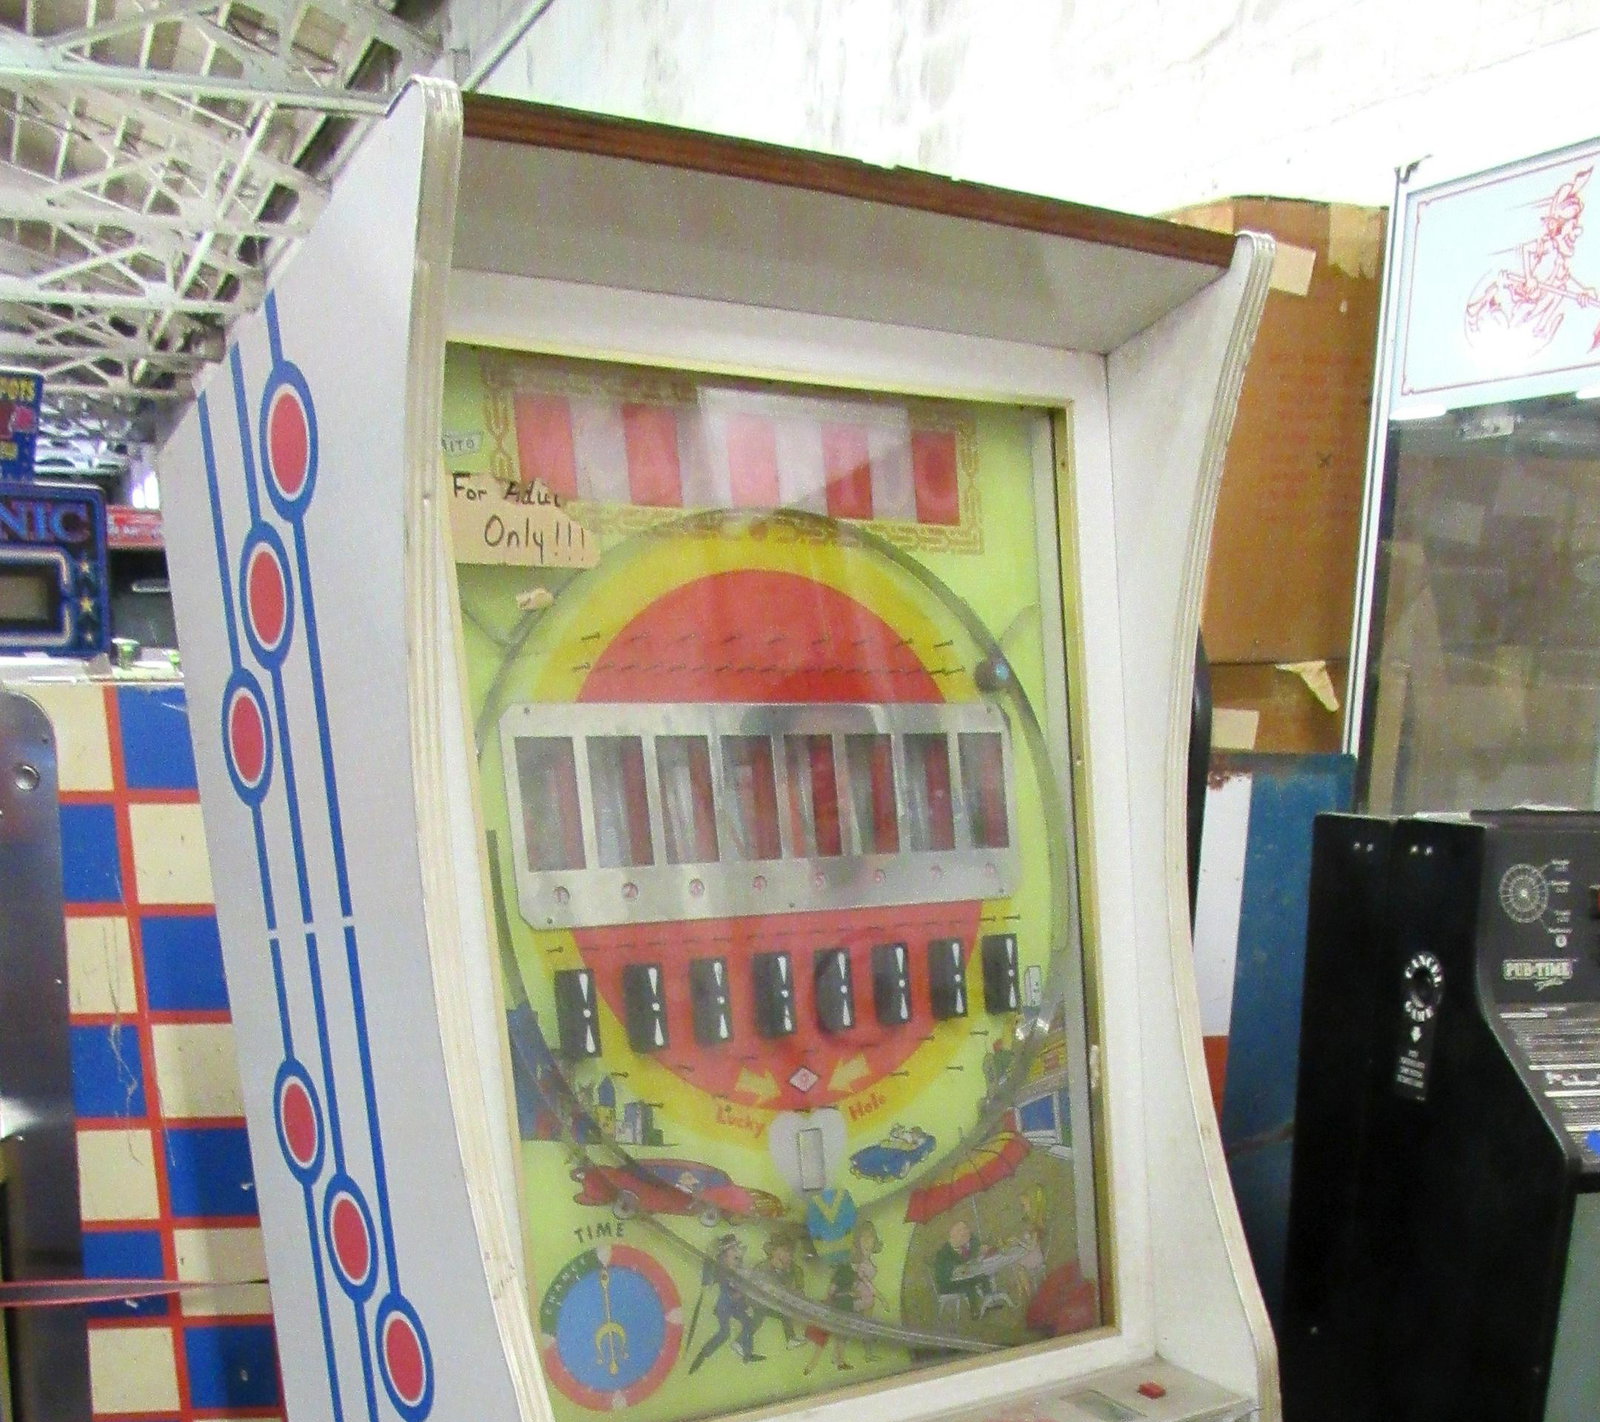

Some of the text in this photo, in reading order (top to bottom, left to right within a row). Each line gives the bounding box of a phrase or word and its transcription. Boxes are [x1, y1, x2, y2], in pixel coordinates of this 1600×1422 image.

[452, 472, 487, 500] For
[484, 514, 585, 565] Only!!!
[716, 1105, 766, 1139] Lucky
[573, 1221, 625, 1244] TIME
